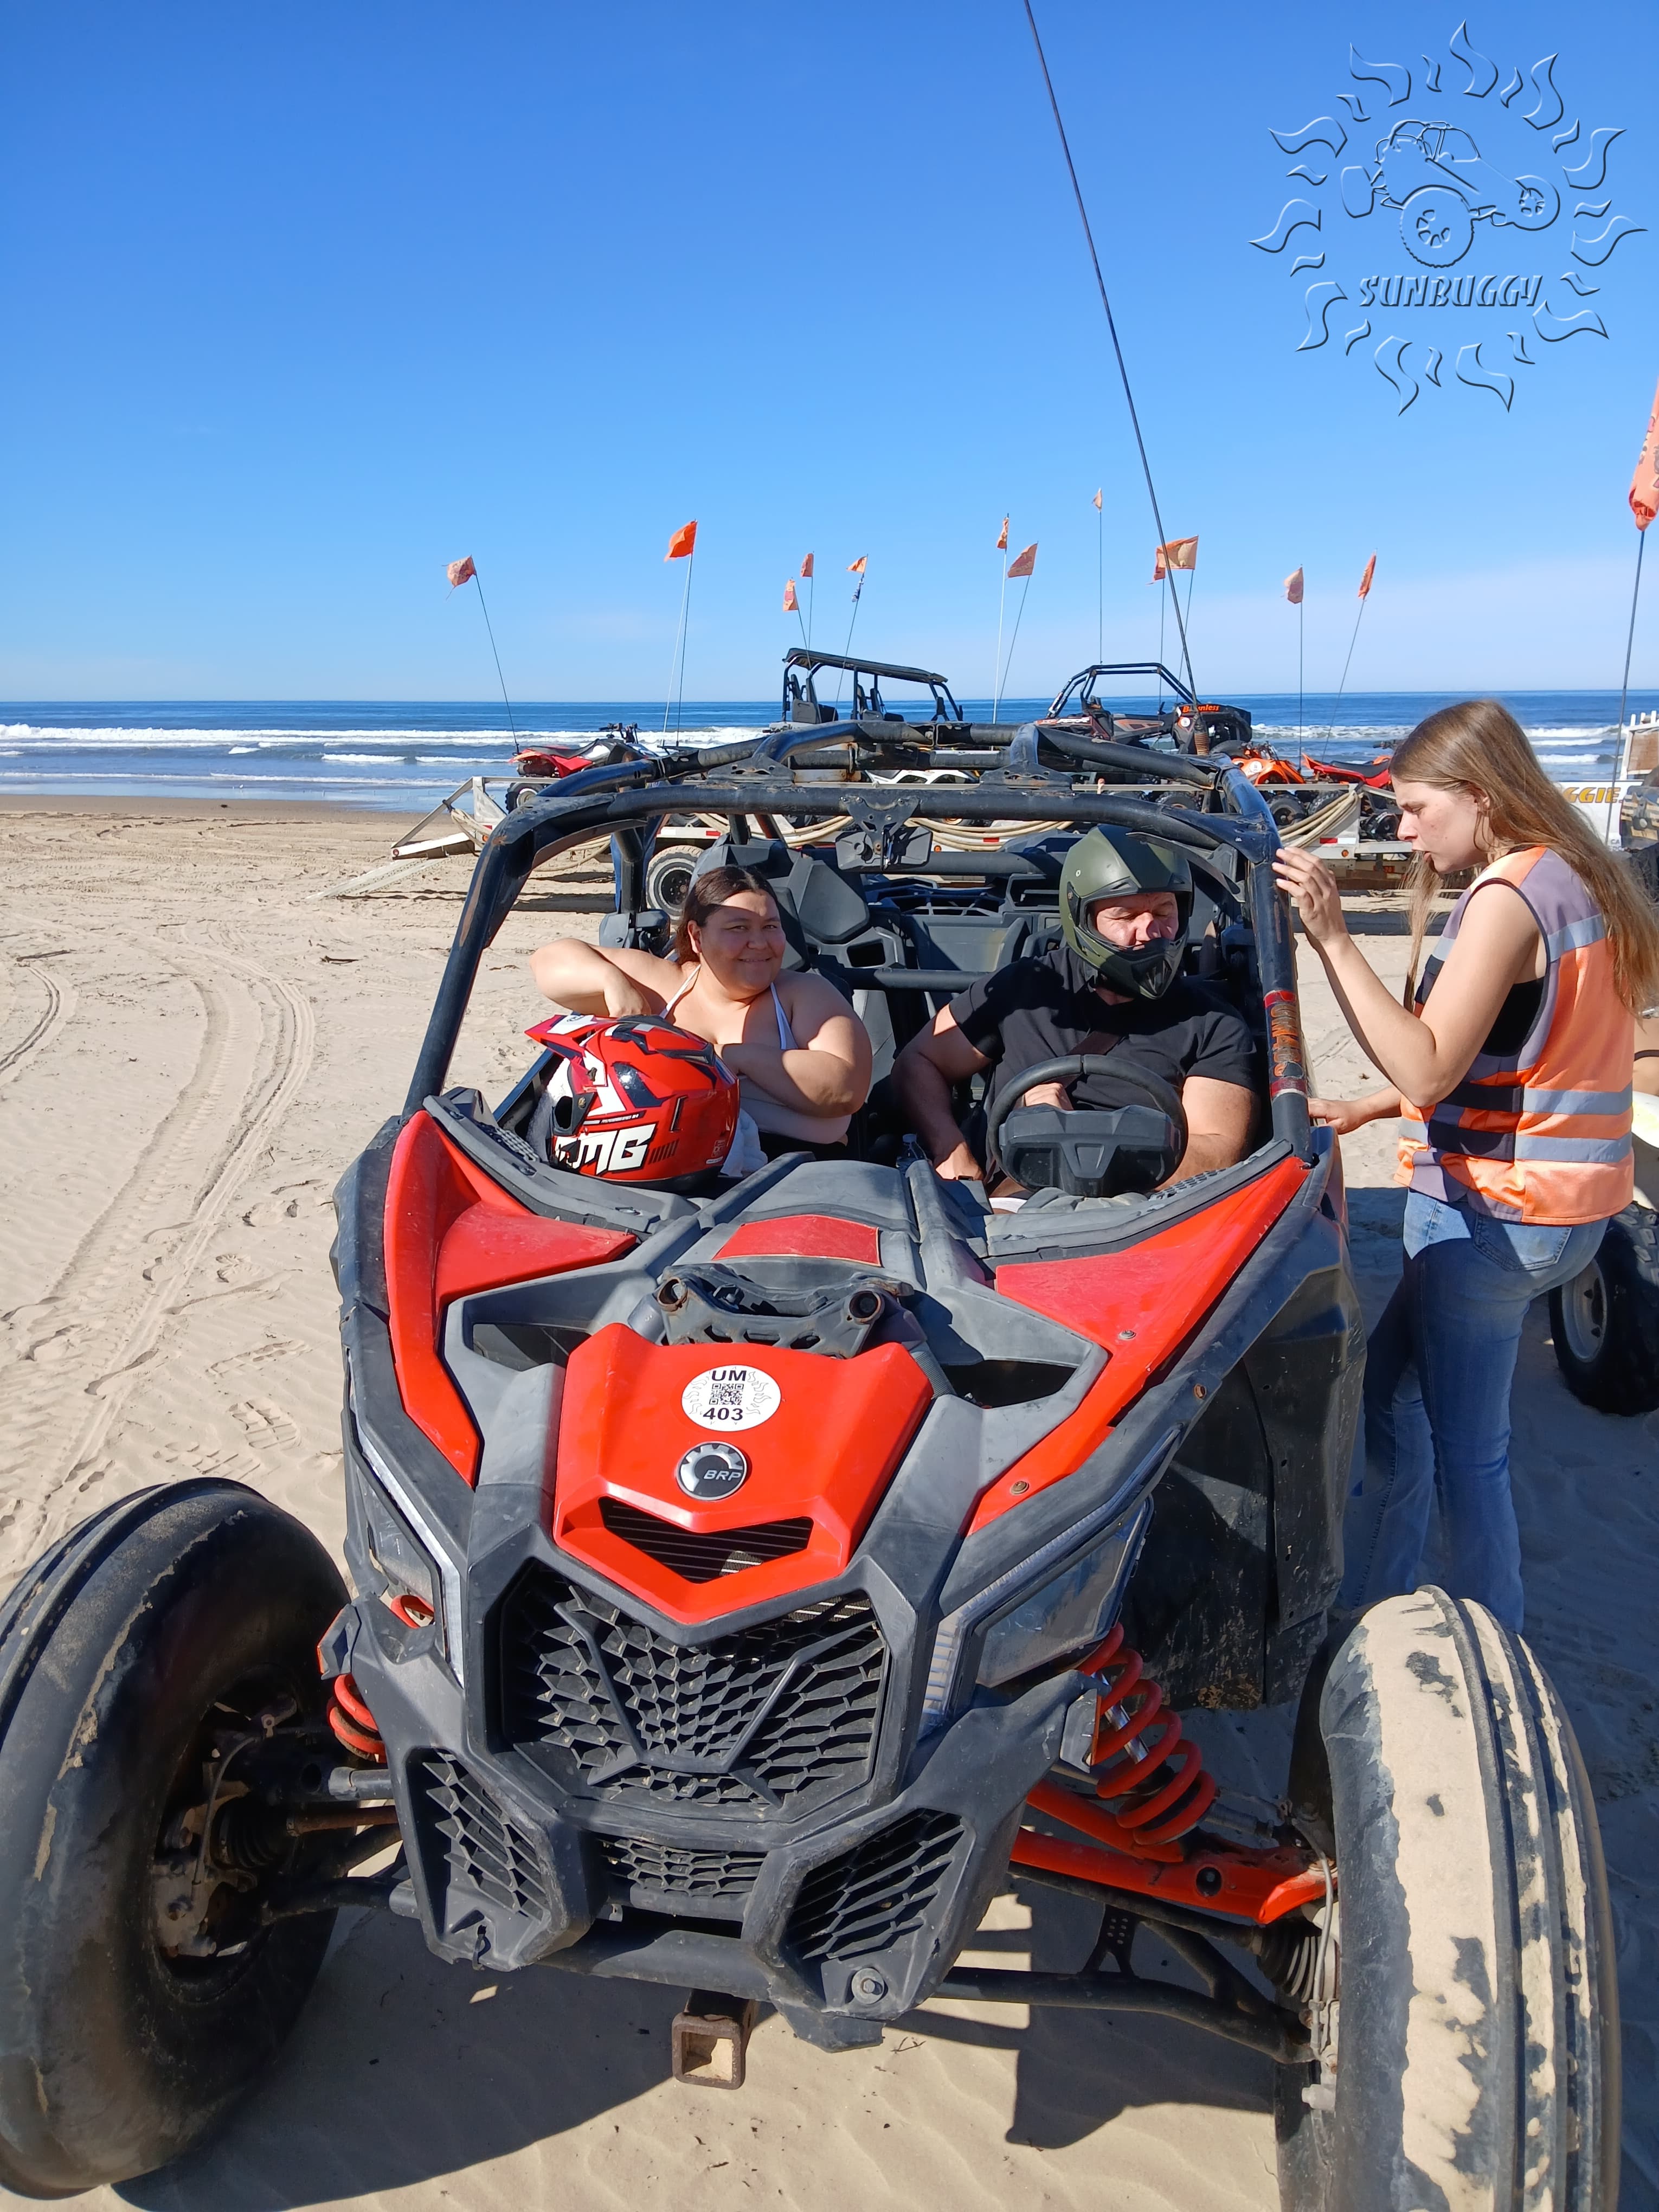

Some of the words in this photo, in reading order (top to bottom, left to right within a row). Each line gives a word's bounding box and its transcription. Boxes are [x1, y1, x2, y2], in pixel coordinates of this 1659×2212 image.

[711, 1370, 747, 1381] UM
[703, 1407, 744, 1420] 403
[703, 1470, 742, 1481] BRP
